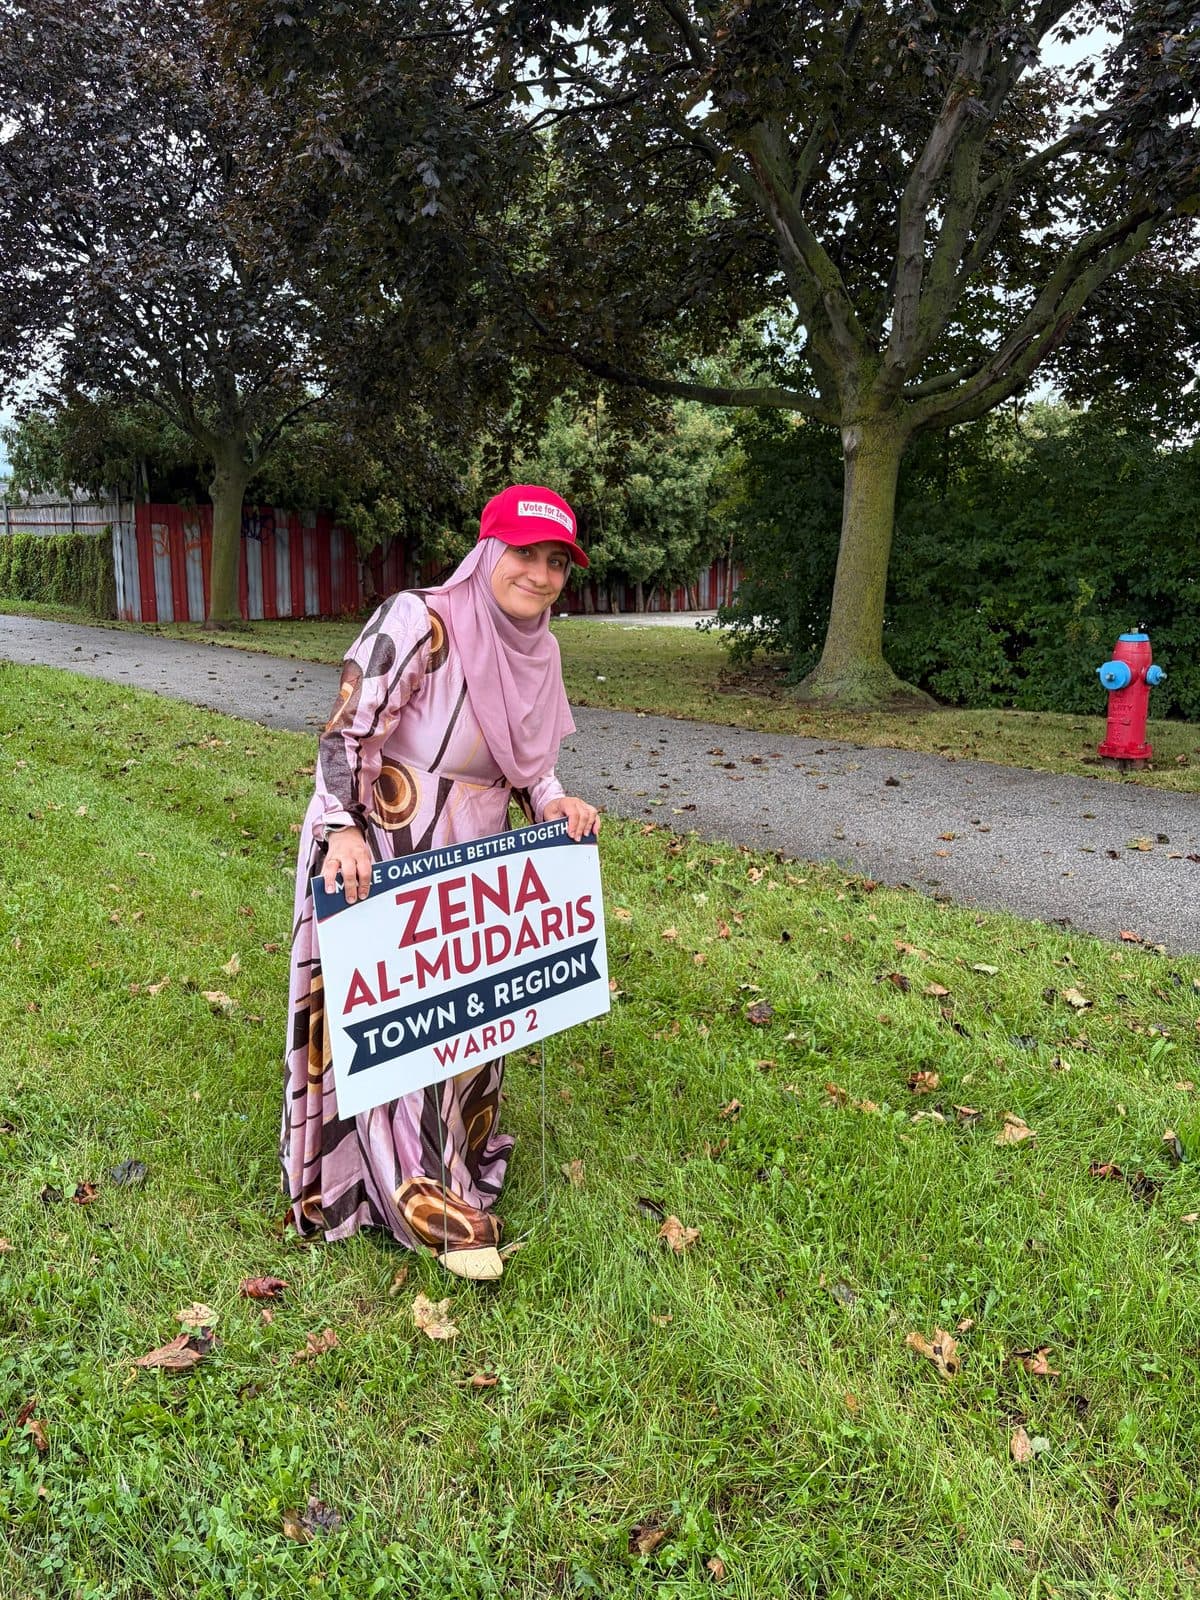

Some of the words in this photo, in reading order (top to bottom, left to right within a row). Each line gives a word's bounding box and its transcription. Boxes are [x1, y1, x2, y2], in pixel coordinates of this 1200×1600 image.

[523, 503, 543, 512] Vote
[544, 505, 555, 515] for
[556, 509, 568, 523] Zena
[335, 869, 383, 893] ME
[387, 849, 462, 881] OAKVILLE
[467, 836, 516, 862] BETTER
[519, 821, 569, 846] TOGETH
[395, 857, 550, 949] ZENA
[342, 895, 595, 1015] AL-MUDARIS
[363, 1001, 457, 1055] TOWN
[466, 993, 485, 1017] &
[494, 953, 587, 1008] REGION
[433, 1018, 515, 1067] WARD
[525, 1008, 538, 1032] 2
